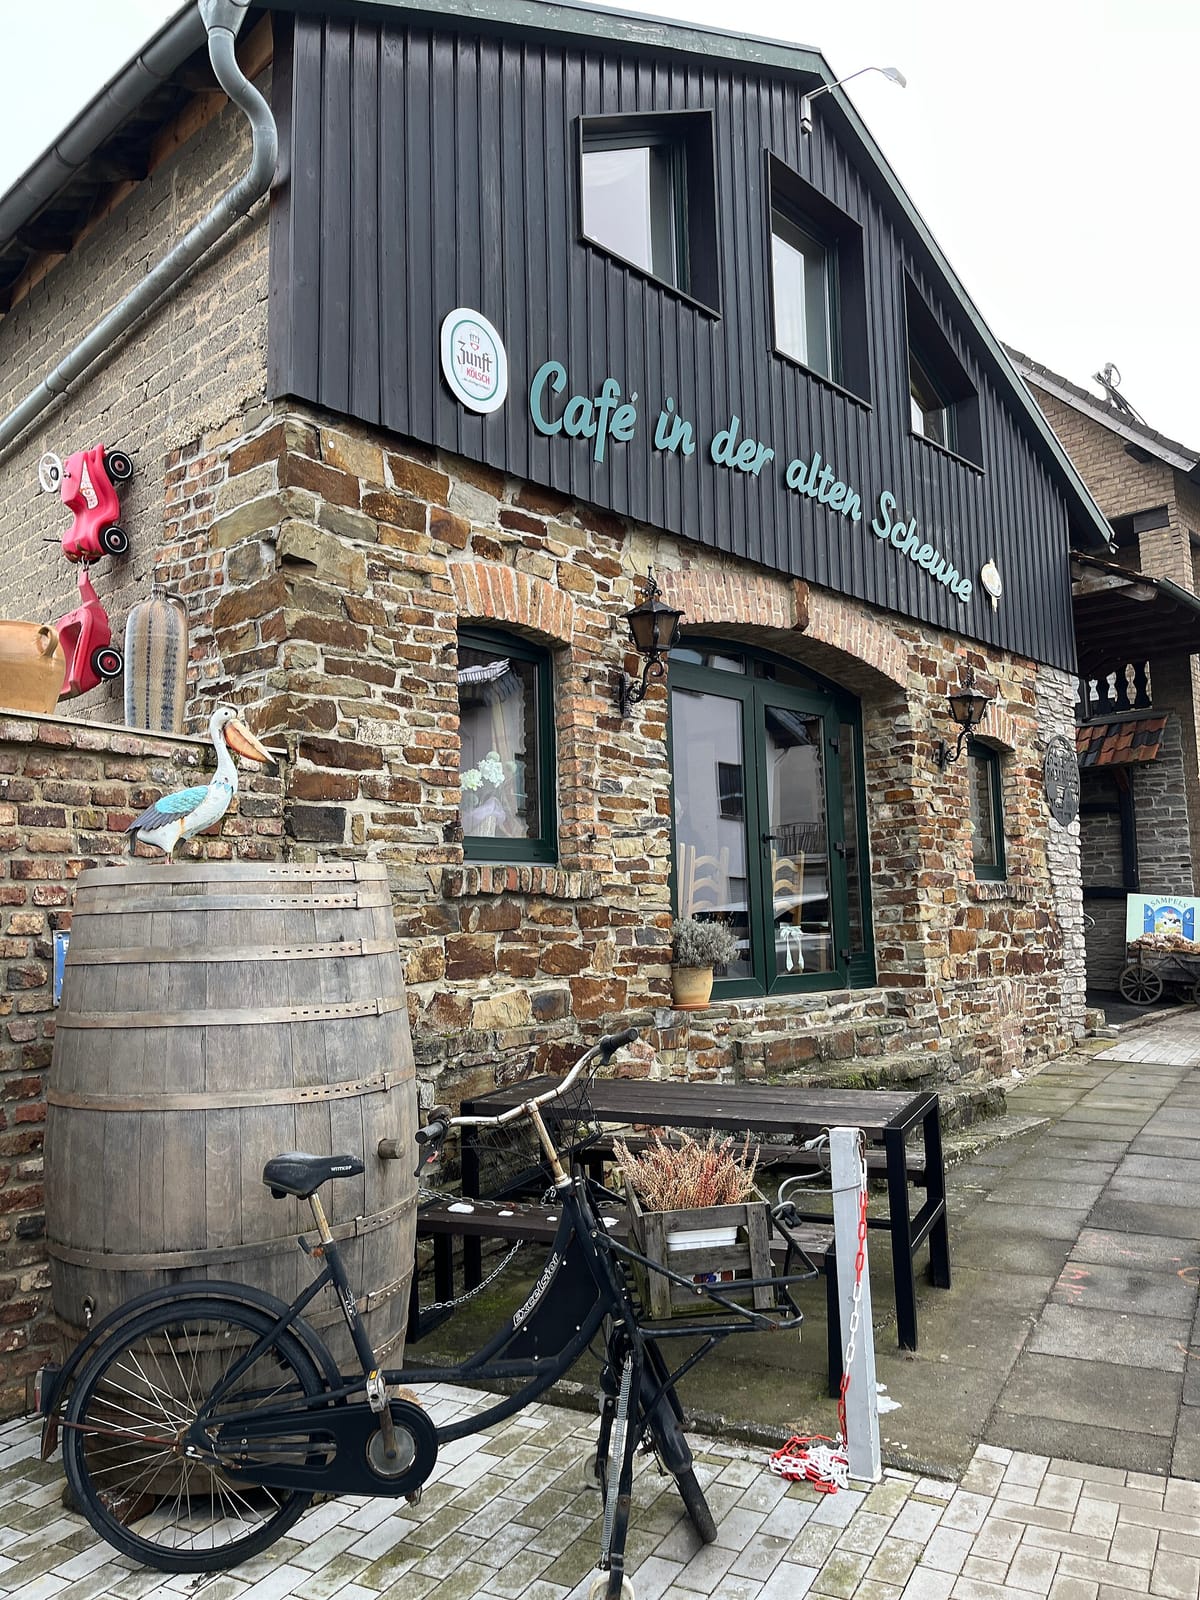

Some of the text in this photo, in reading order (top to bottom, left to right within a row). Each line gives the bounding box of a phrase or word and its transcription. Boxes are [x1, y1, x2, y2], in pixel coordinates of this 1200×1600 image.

[457, 340, 492, 373] Zunft
[466, 367, 490, 385] KÖLSCH
[530, 361, 972, 603] Café in der alten Scheune
[1150, 897, 1188, 909] SAMPELS
[513, 1251, 559, 1328] Excelsior
